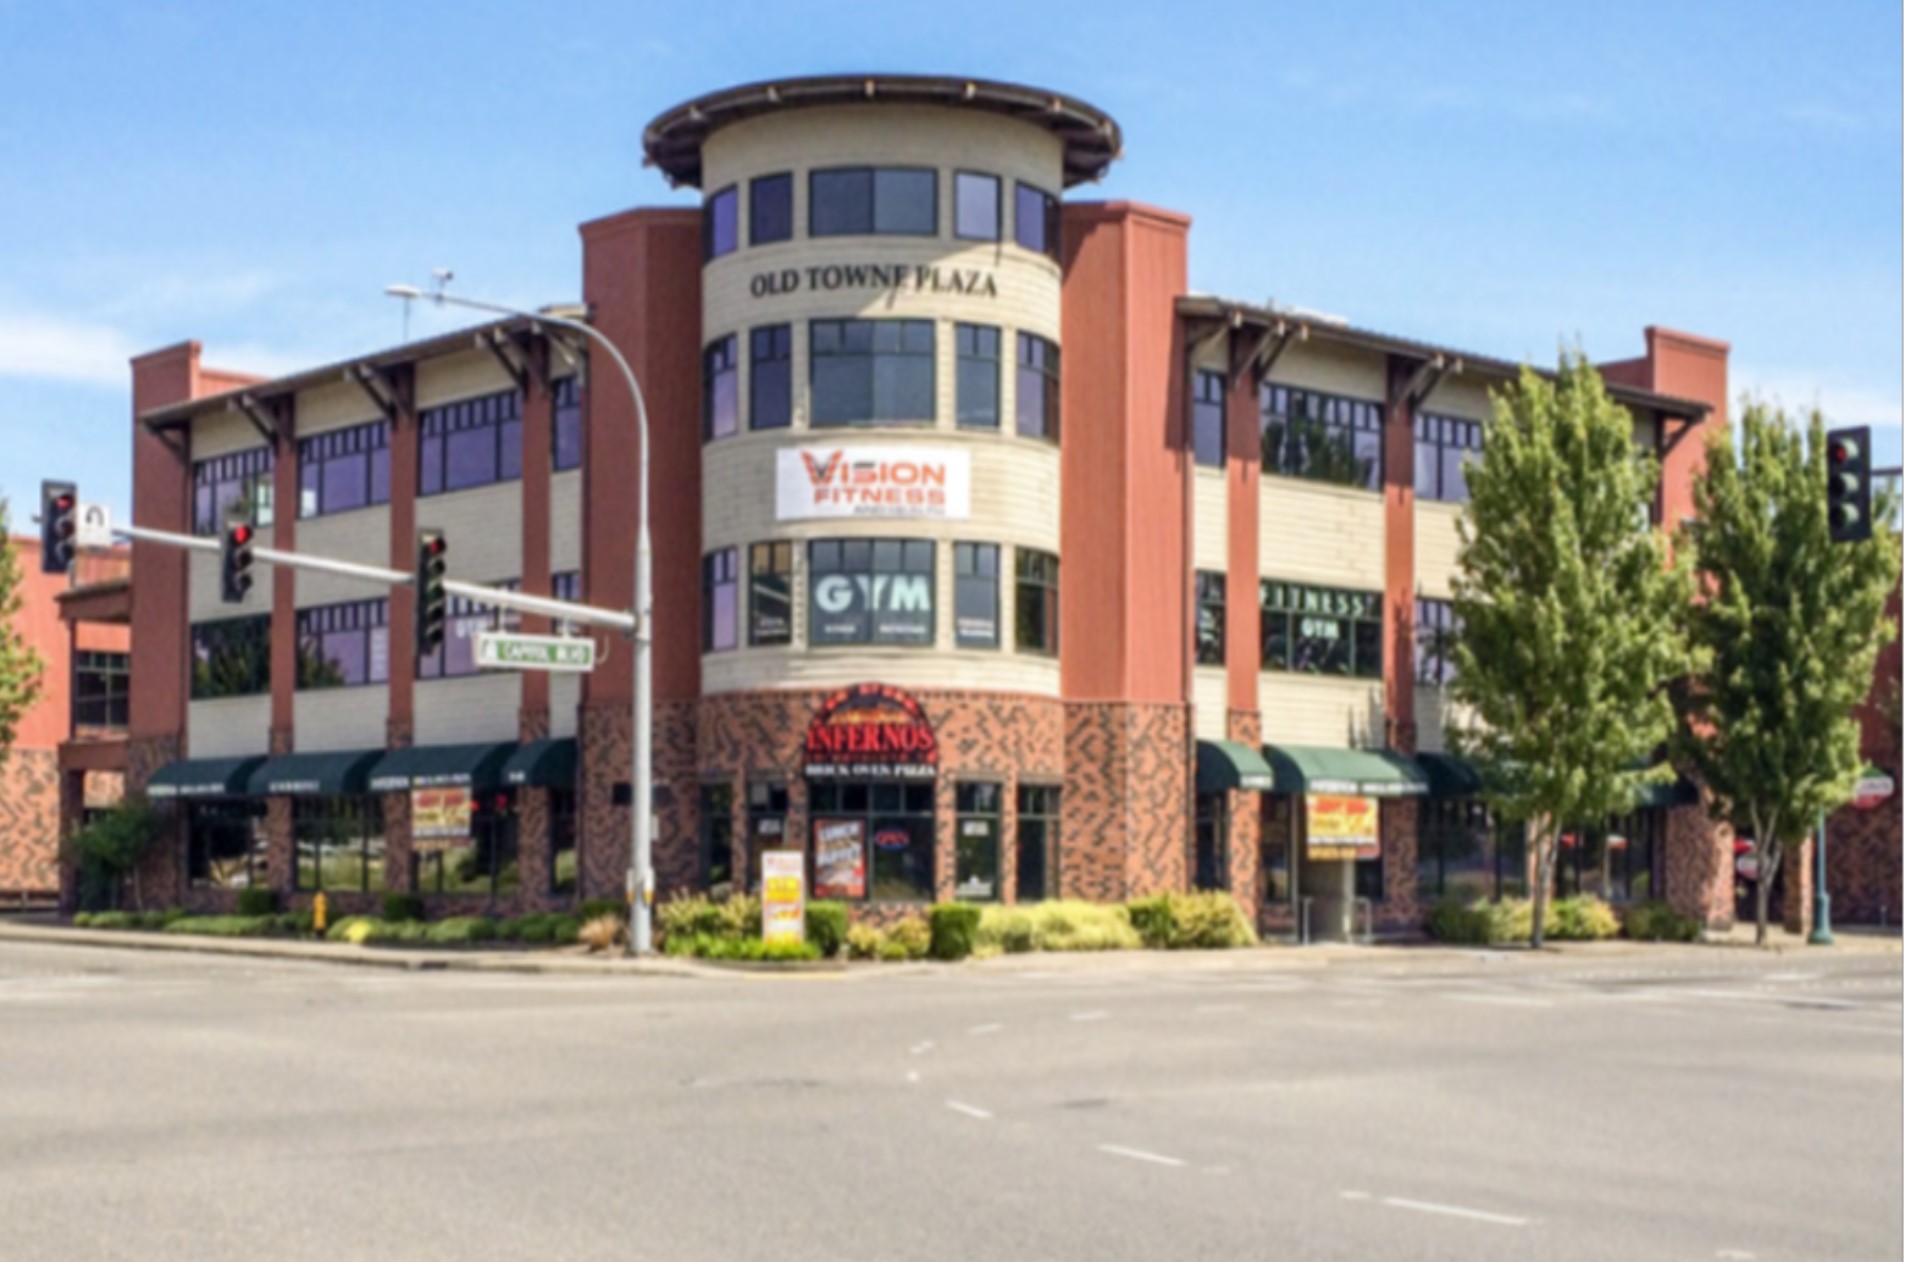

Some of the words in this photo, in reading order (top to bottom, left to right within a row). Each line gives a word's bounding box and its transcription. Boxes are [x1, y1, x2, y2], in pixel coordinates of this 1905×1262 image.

[750, 268, 799, 298] OLD
[806, 263, 911, 292] TOWNE
[915, 265, 998, 299] PLAZA
[801, 450, 946, 486] VISION
[814, 487, 946, 505] FITNESS
[815, 574, 931, 613] GYM
[1260, 584, 1364, 617] FITNESS
[1301, 617, 1339, 639] GYM
[504, 641, 550, 662] CAPITOL
[807, 722, 935, 751] INFERNOS
[805, 763, 849, 777] BRICK
[852, 763, 891, 777] OVEN
[894, 763, 937, 777] PIZZA
